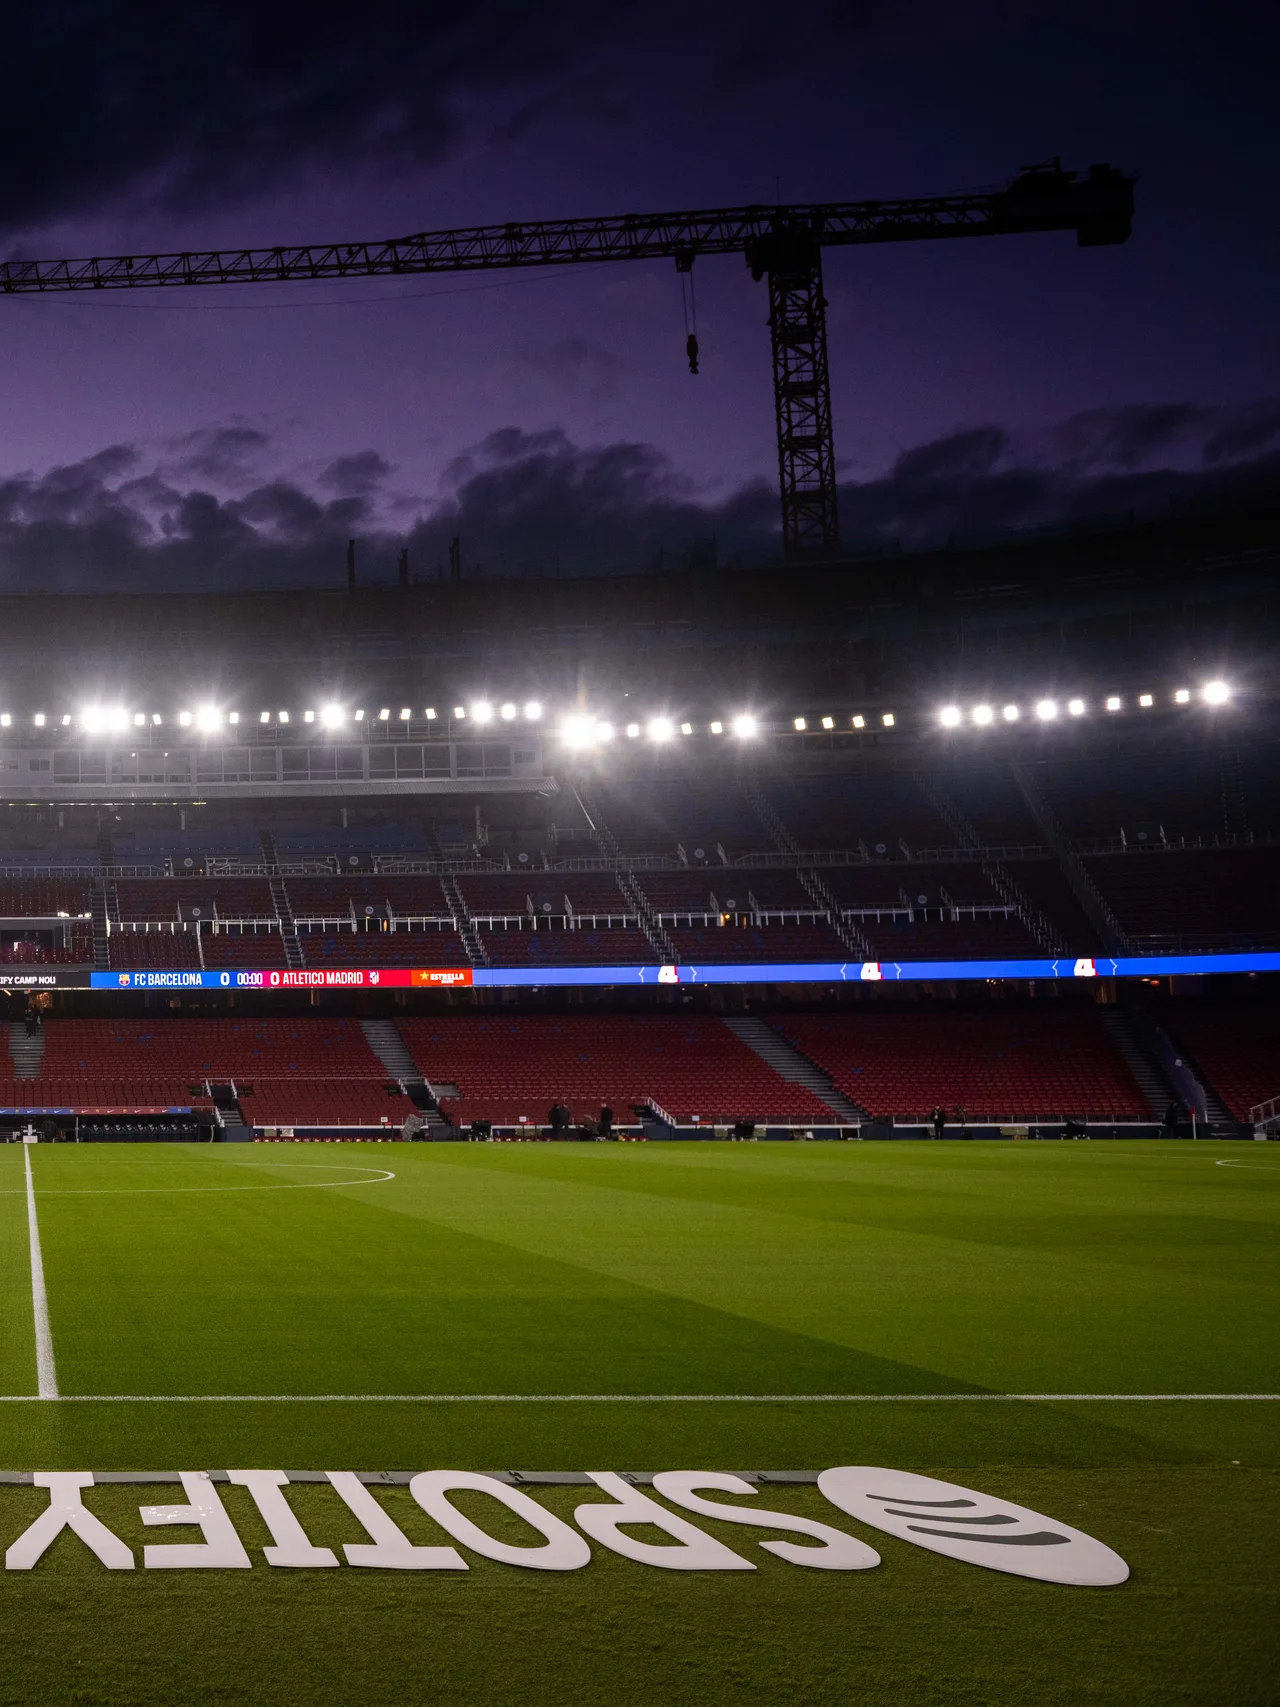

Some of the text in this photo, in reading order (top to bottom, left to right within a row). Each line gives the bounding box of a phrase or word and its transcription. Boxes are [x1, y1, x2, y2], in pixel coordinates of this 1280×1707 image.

[14, 976, 38, 985] CAMP
[38, 976, 56, 985] NOU
[133, 972, 364, 986] FC BARCELONA 0 00:00 0 ATLETICO MADRID
[430, 973, 465, 981] ESTRELLA
[6, 1470, 882, 1571] SPOTIFY
